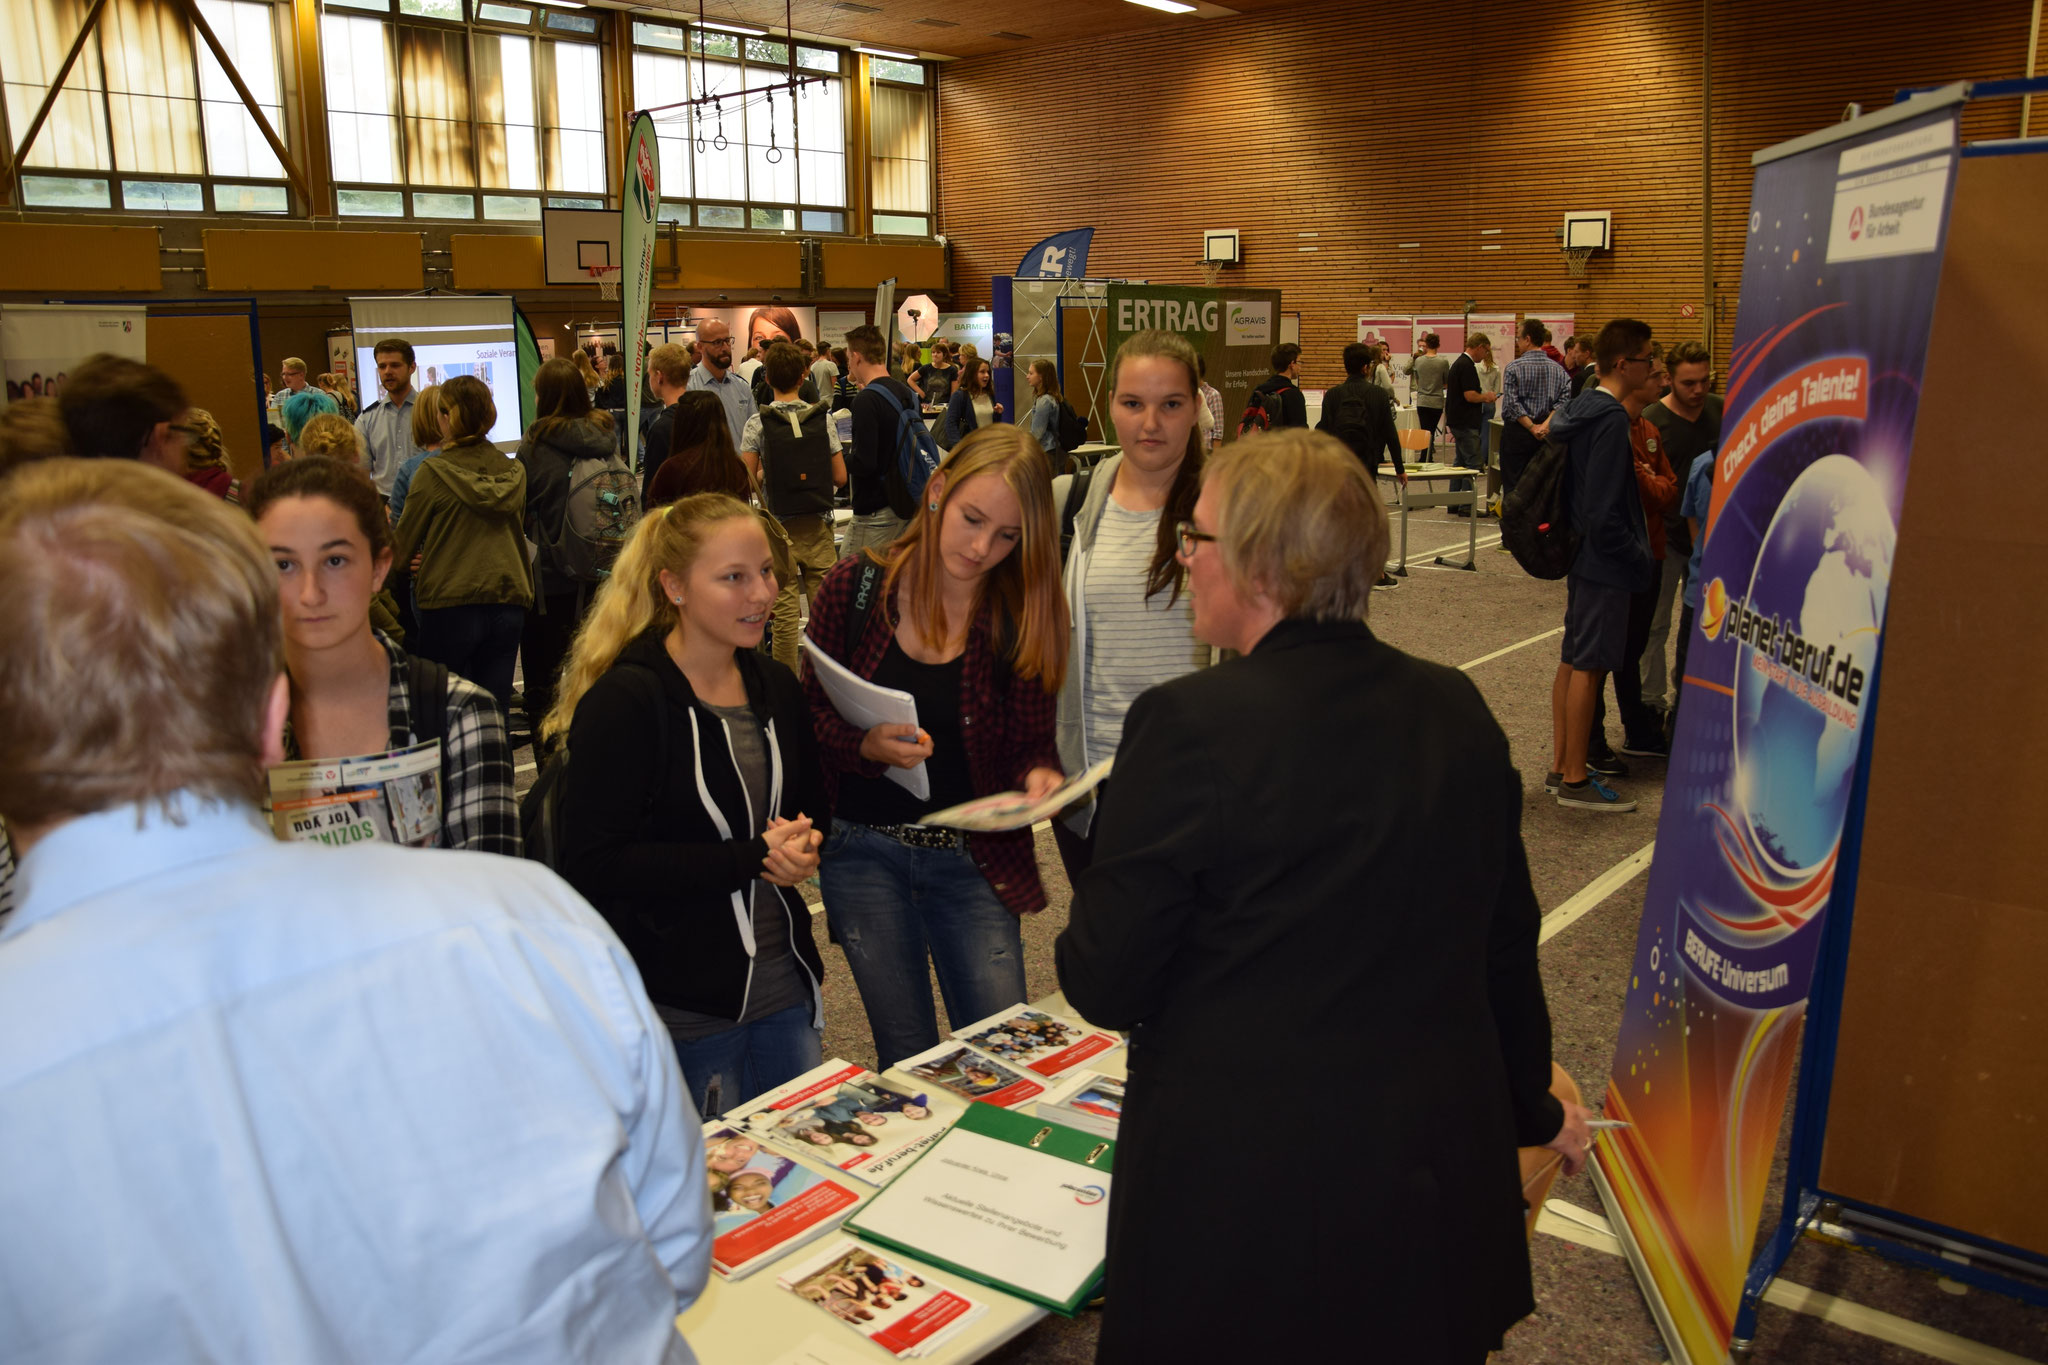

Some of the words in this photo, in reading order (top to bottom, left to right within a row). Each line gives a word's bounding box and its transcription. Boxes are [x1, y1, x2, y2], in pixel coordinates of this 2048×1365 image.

[1868, 196, 1925, 219] Bundesagentur
[1866, 223, 1876, 239] für
[1877, 222, 1901, 237] Arbeit
[1066, 246, 1077, 277] ewegt!
[954, 323, 990, 331] BARMER
[1118, 299, 1218, 332] ERTRAG
[1234, 317, 1266, 325] AGRAVIS
[476, 348, 498, 359] Soziale
[1225, 370, 1242, 378] Unsere
[1723, 421, 1758, 483] Check
[1760, 389, 1798, 436] deine
[1801, 367, 1861, 408] Talente!
[856, 566, 875, 610] DAKINE
[1724, 597, 1864, 707] planet-beruf.de
[1808, 689, 1857, 730] AUSBILDUNG
[294, 814, 322, 832] you
[328, 810, 351, 825] for
[1684, 928, 1789, 993] BERUFE-Universum
